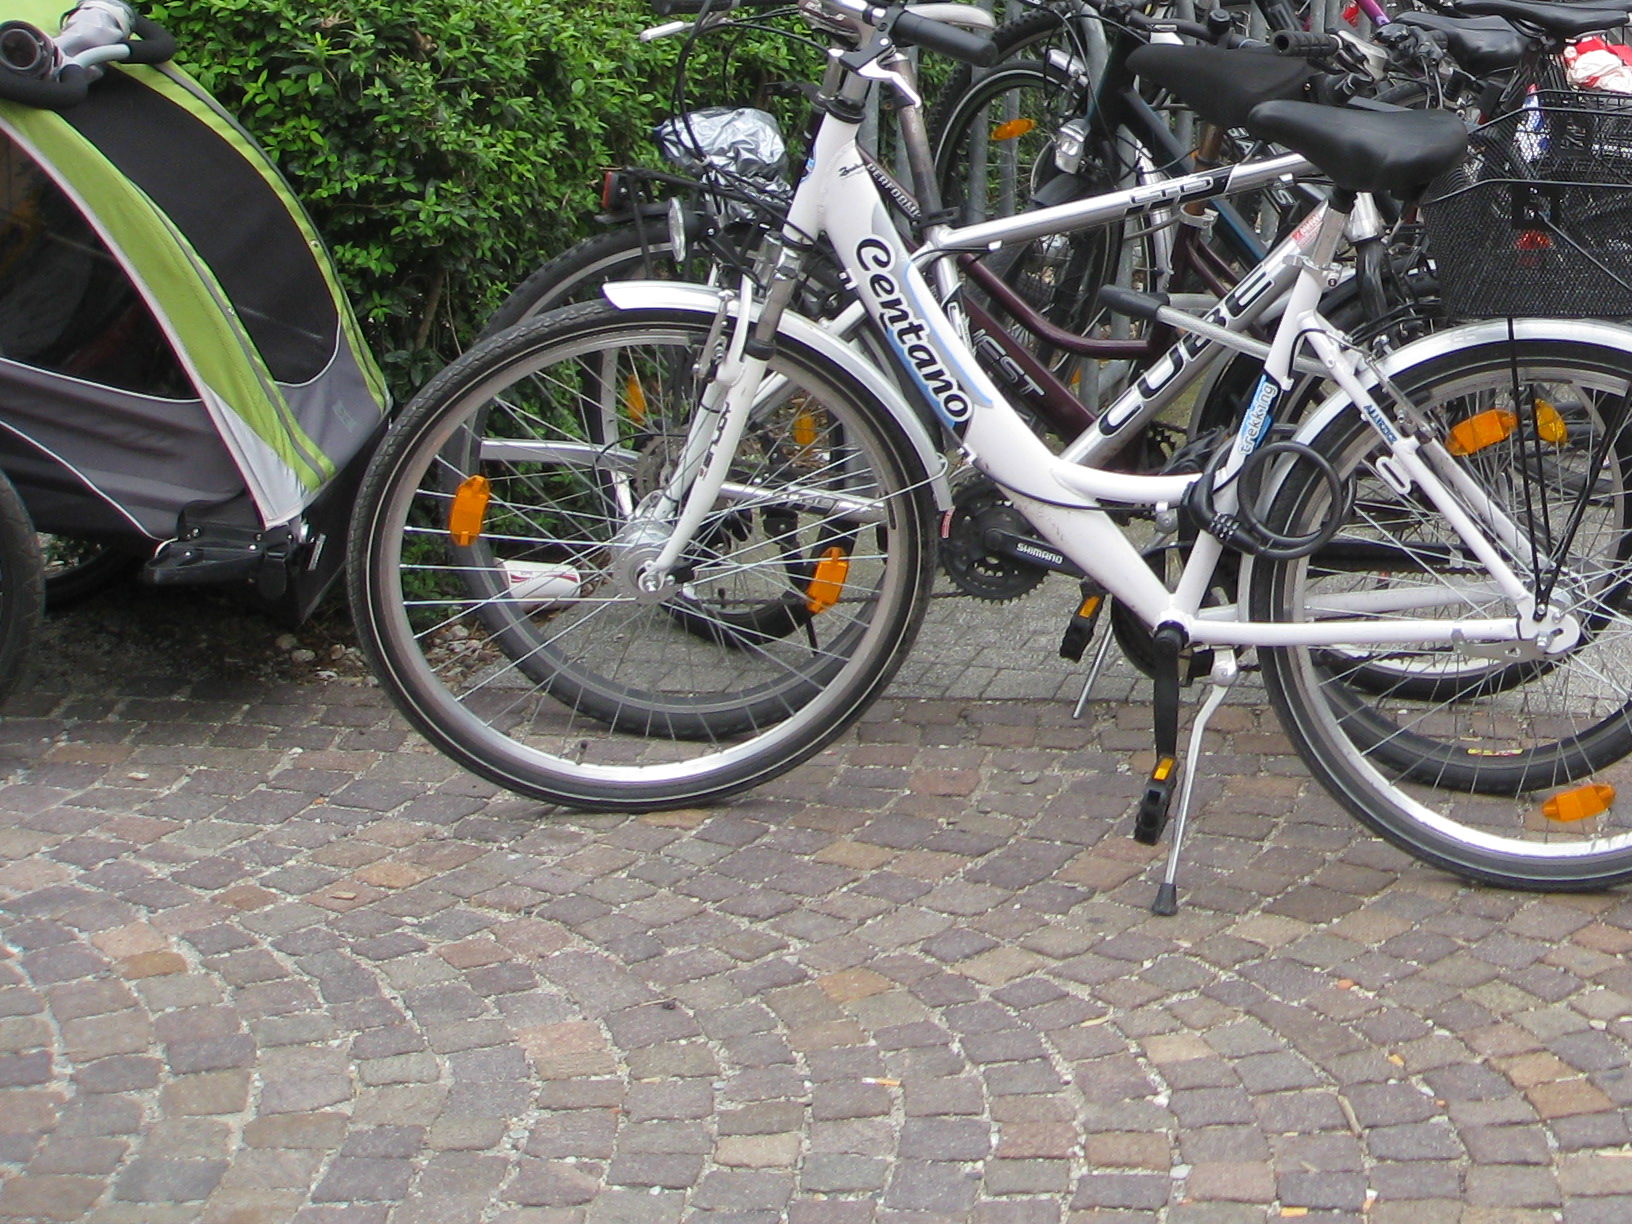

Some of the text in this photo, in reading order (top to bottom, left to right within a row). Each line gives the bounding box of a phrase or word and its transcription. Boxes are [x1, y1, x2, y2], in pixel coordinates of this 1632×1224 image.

[855, 236, 970, 419] Centano
[1239, 382, 1279, 455] trekking
[1016, 542, 1063, 564] SHIMANO
